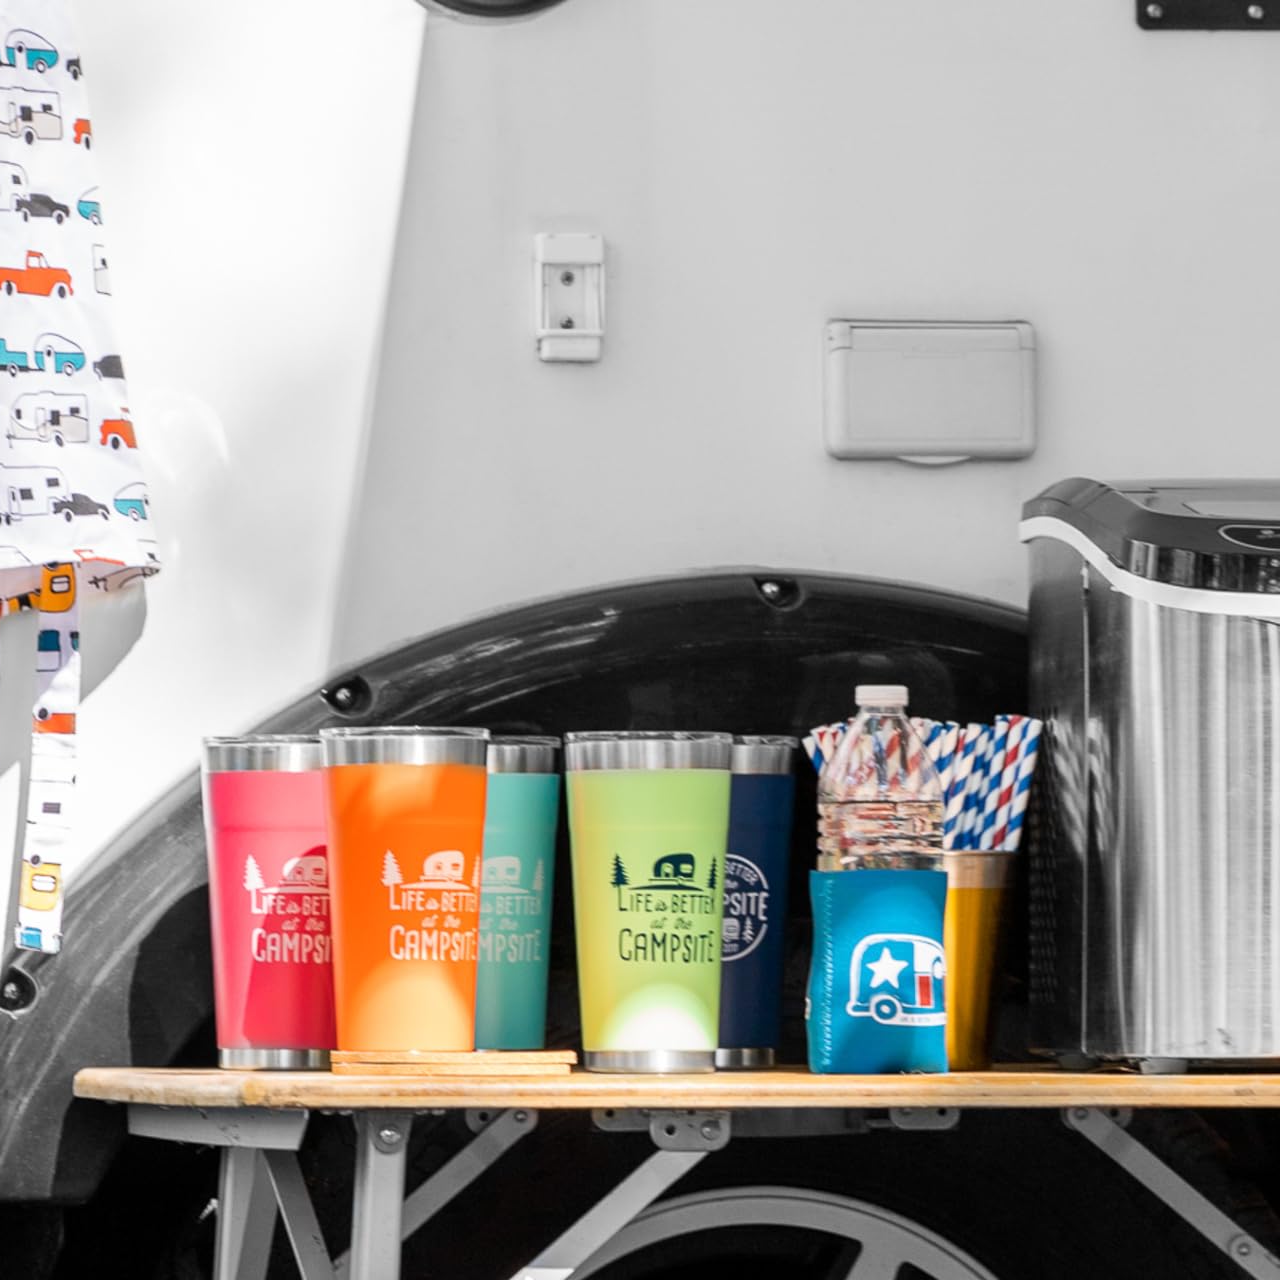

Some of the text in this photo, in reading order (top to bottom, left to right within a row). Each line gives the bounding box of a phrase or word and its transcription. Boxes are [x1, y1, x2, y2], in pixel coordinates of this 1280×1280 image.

[250, 891, 287, 915] LIFE
[301, 895, 330, 917] BET
[389, 887, 425, 911] LIFE
[618, 892, 653, 913] LIFE
[723, 891, 769, 922] PSITE
[281, 917, 301, 932] at
[421, 914, 462, 929] at the
[650, 917, 692, 931] at the
[251, 927, 331, 965] CAMPSI
[389, 924, 478, 962] CAMPSITE
[478, 929, 543, 963] MPSITE
[619, 928, 716, 964] CAMPSITE
